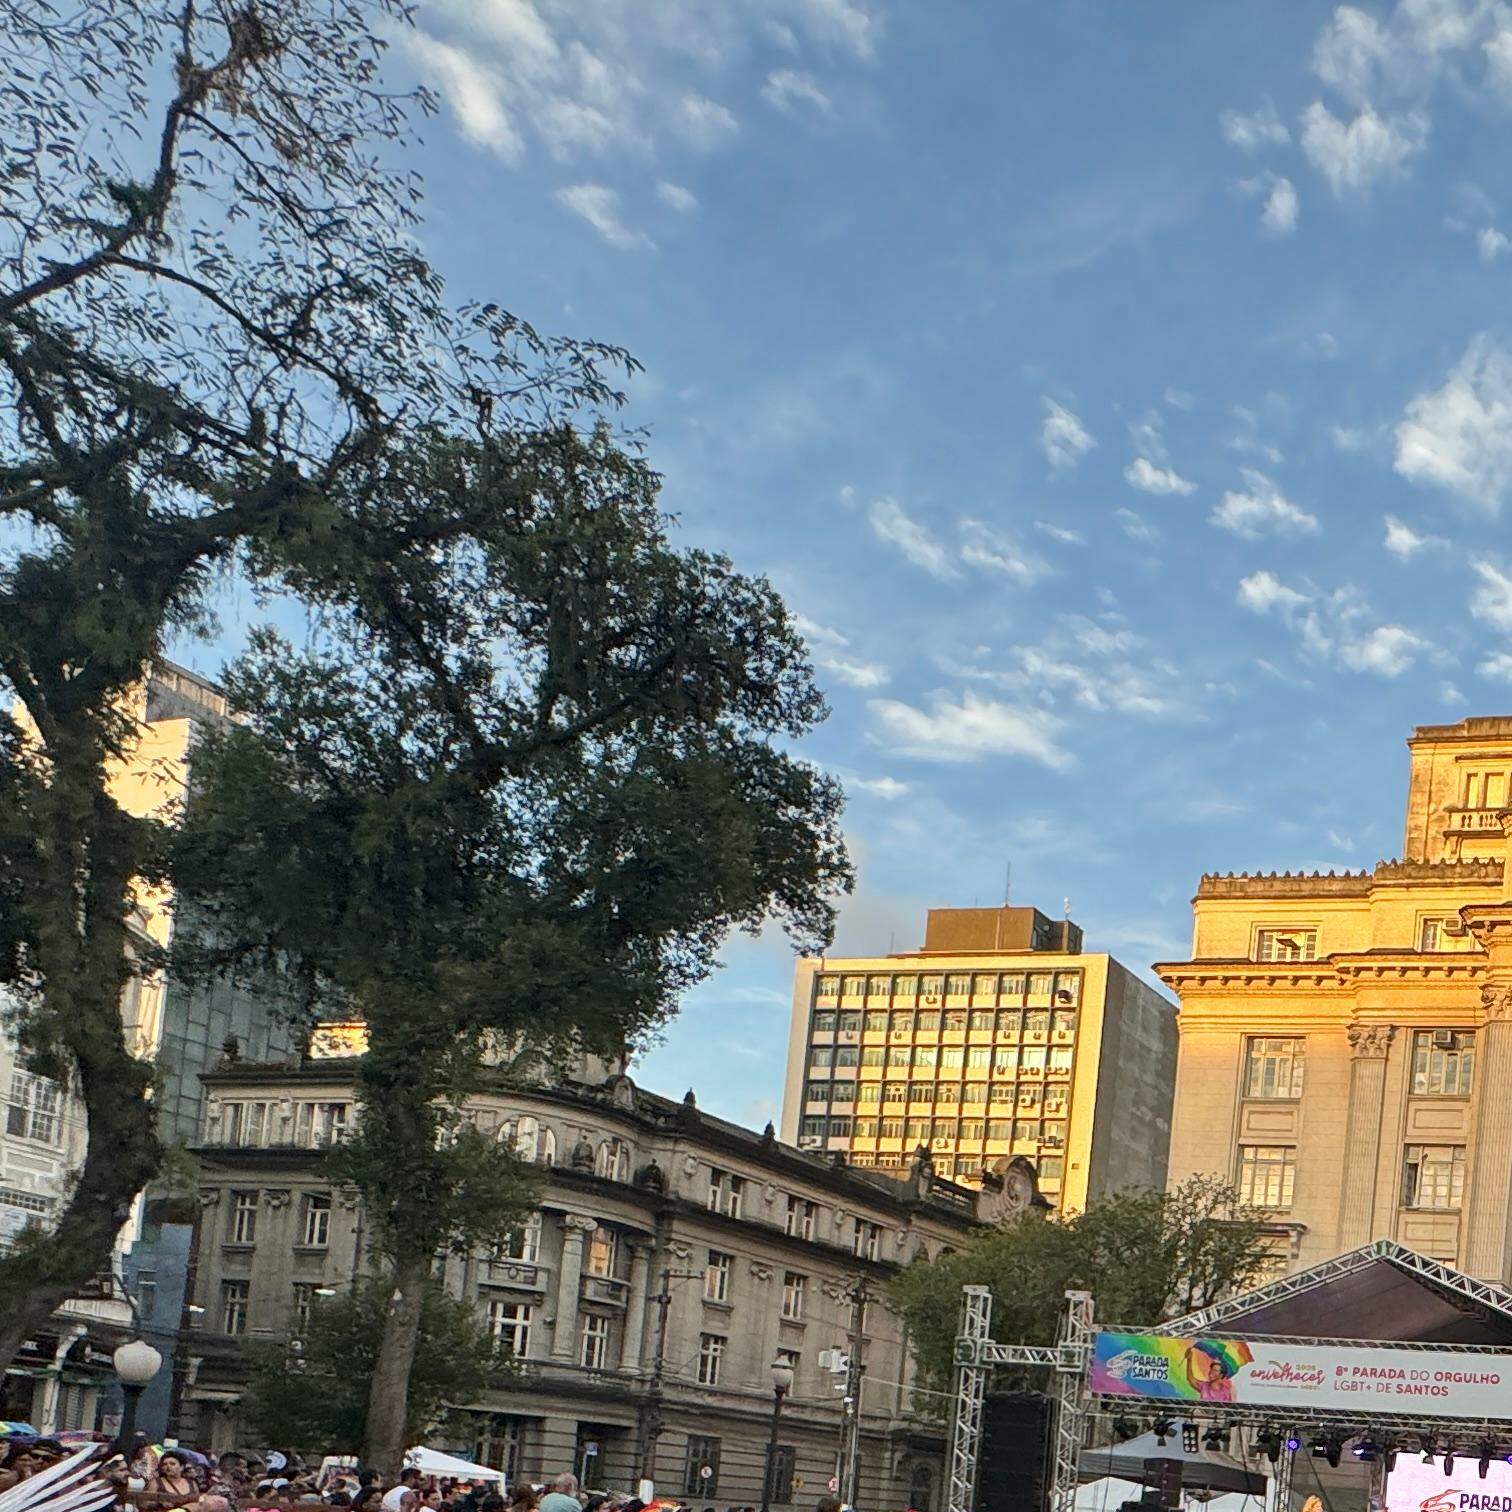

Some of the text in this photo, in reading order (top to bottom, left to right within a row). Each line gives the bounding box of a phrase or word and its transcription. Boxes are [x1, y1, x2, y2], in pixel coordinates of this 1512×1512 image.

[1133, 1355, 1169, 1368] PARADA
[1132, 1367, 1168, 1380] SANTOS
[1352, 1366, 1406, 1380] PARADA
[1410, 1370, 1430, 1381] DO
[1434, 1372, 1501, 1385] ORGULHO
[1334, 1380, 1371, 1392] LGBT+
[1376, 1382, 1392, 1393] DE
[1396, 1384, 1449, 1397] SANTOS
